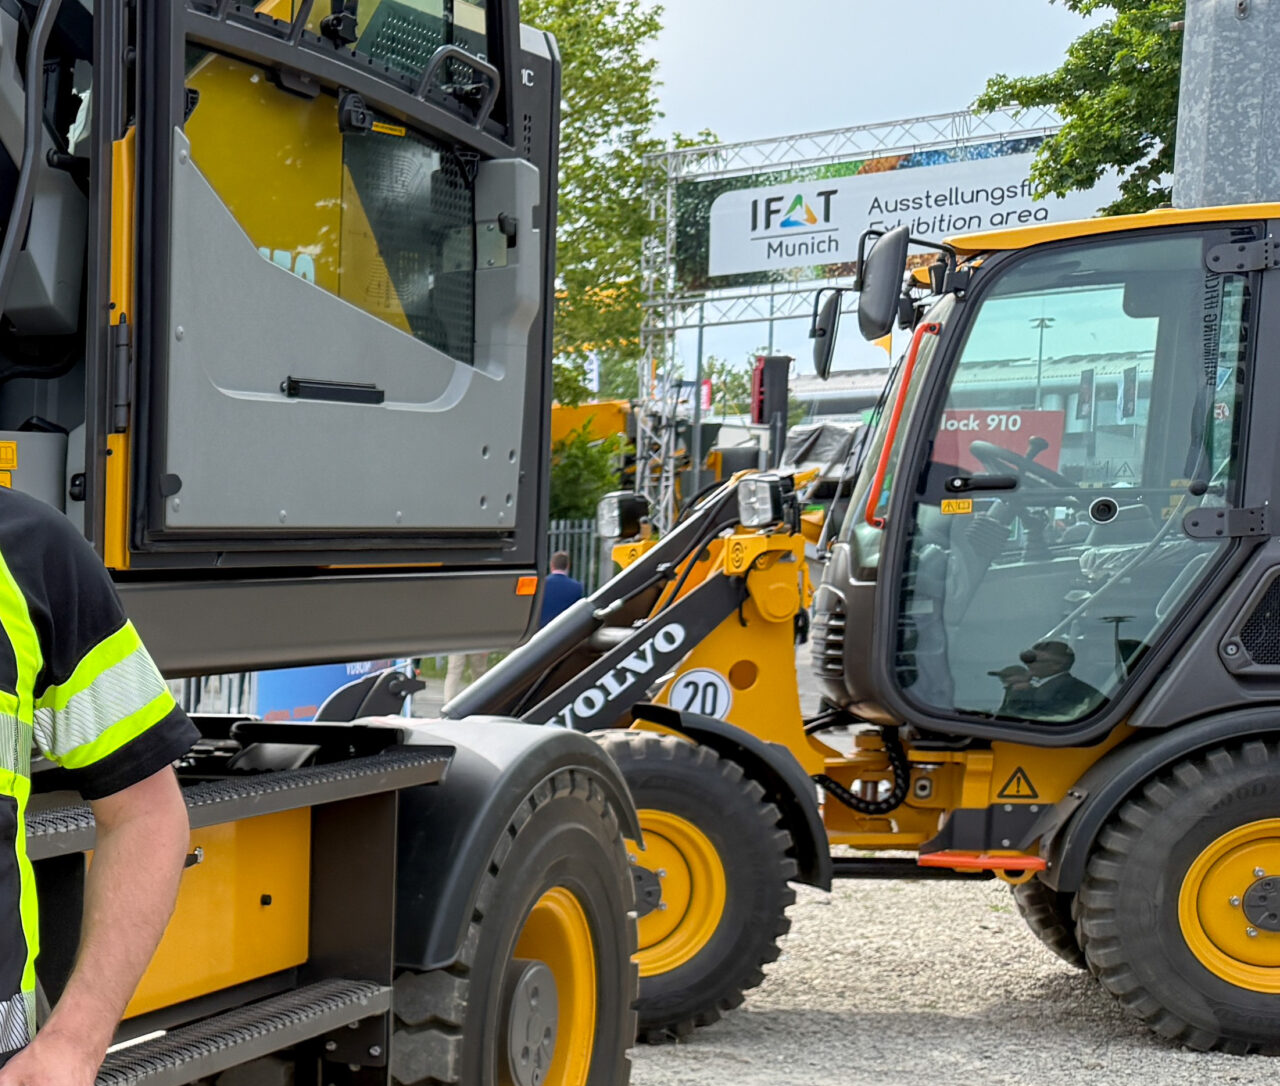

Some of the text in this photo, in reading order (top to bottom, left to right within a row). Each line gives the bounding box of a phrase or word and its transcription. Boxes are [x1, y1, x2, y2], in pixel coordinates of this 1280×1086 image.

[751, 189, 838, 232] IFAT
[990, 207, 1049, 227] area
[766, 234, 839, 260] Munich
[940, 413, 1021, 432] lock 910
[543, 622, 686, 731] VOLVO
[682, 681, 719, 717] 20
